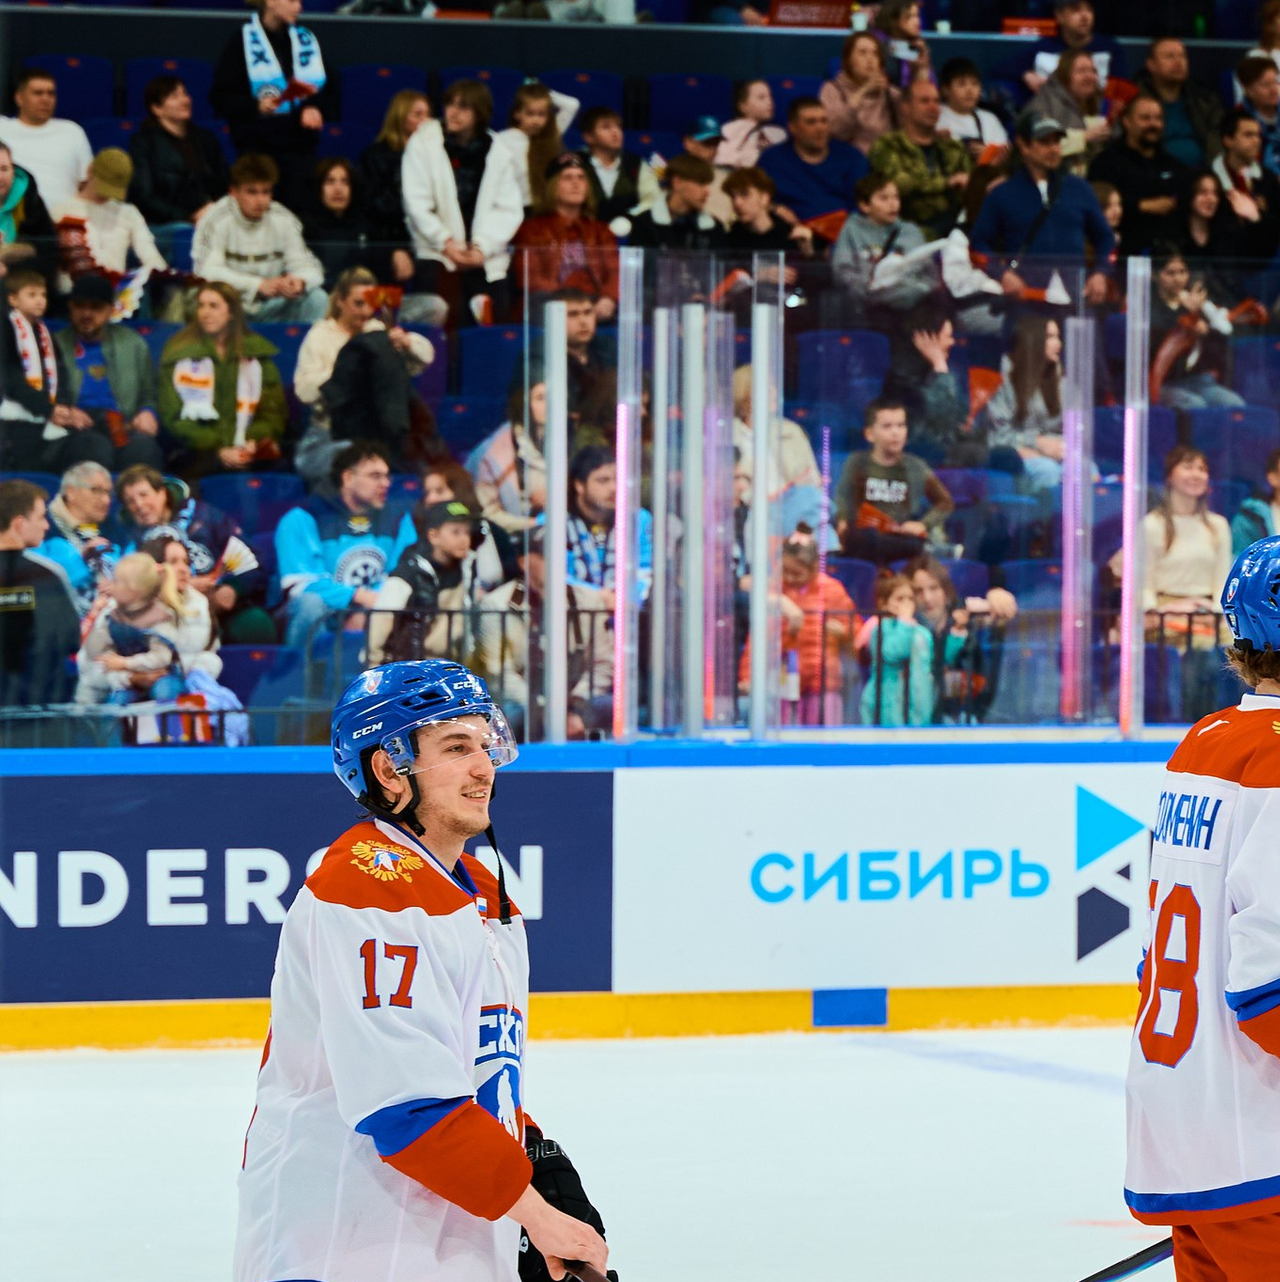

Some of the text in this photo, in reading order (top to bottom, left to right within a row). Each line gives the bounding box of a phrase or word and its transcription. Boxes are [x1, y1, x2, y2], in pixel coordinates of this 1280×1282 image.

[352, 721, 384, 740] CCM
[0, 845, 543, 928] NDERN
[750, 848, 1050, 903] СИБИРЬ
[360, 938, 419, 1009] 17
[1138, 879, 1203, 1070] 8
